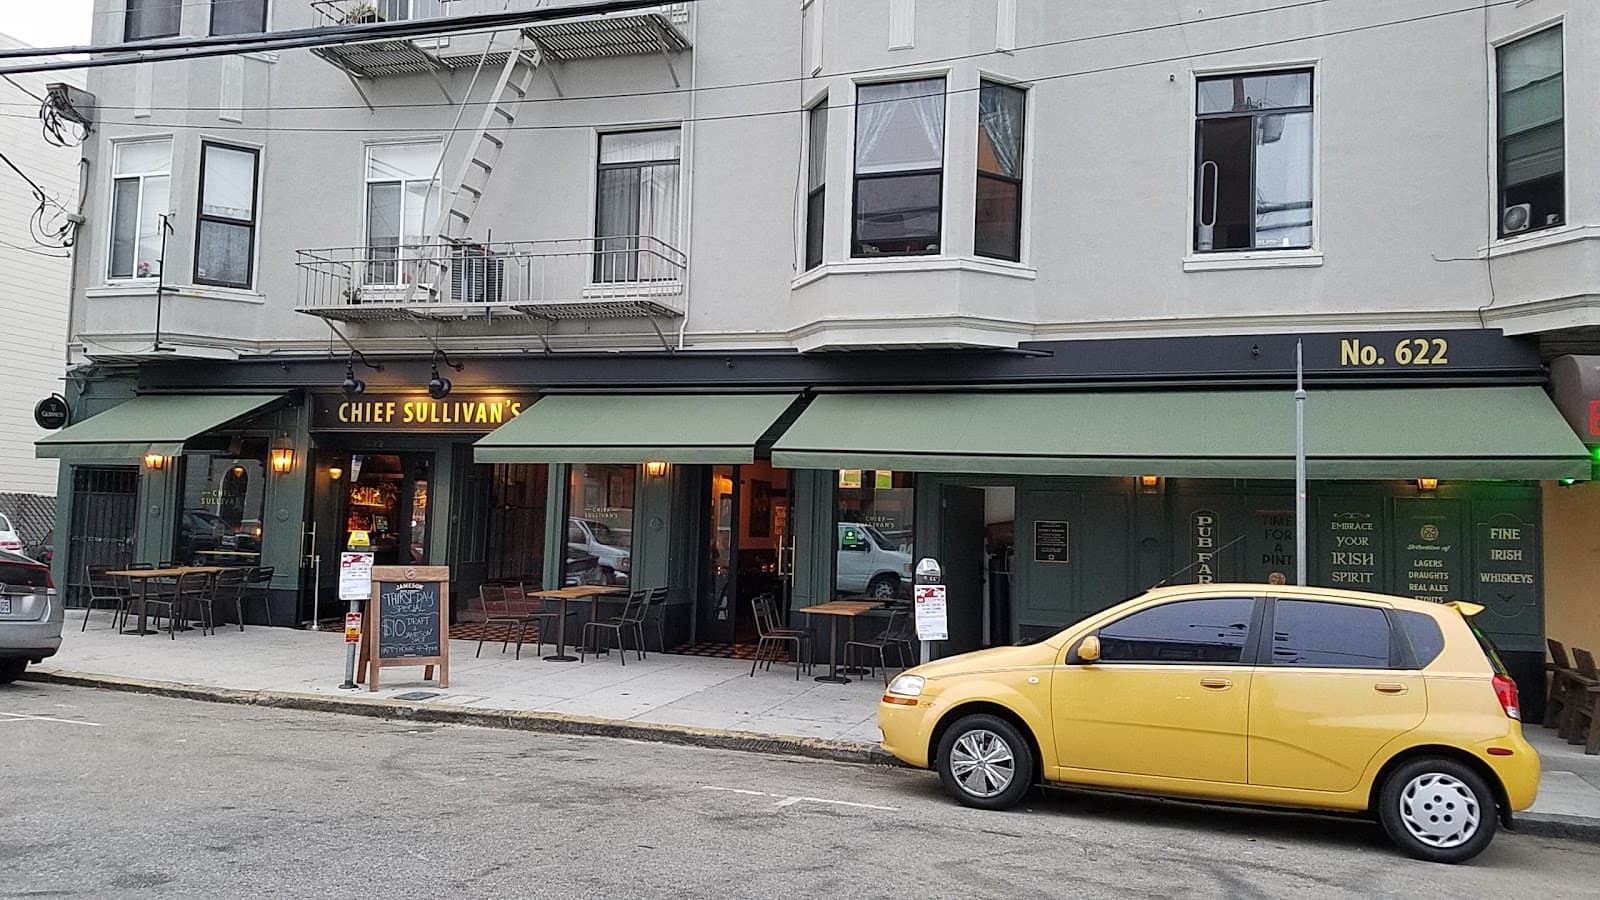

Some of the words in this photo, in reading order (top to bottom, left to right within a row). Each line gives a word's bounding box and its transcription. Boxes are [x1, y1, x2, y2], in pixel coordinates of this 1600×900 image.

[1341, 339, 1385, 366] No.
[1395, 338, 1448, 365] 622
[338, 402, 396, 423] CHIEF
[403, 400, 521, 423] SULLIVAN'S
[1263, 515, 1293, 527] TIME
[1331, 522, 1373, 530] EMBRACE
[1197, 516, 1213, 548] PUB
[1265, 529, 1293, 540] FOR
[1490, 528, 1520, 540] FINE
[1274, 543, 1283, 552] A
[1336, 537, 1369, 547] YOUR
[1262, 553, 1293, 565] PINT
[1331, 552, 1374, 566] IRISH
[1491, 549, 1522, 560] IRISH
[1414, 560, 1443, 568] LAGERS
[1331, 571, 1374, 583] SPIRIT
[1408, 572, 1449, 580] DRAUGHTS
[1480, 573, 1533, 584] WHISKEYS
[1408, 584, 1427, 592] REAL
[1429, 584, 1449, 592] ALES
[381, 618, 407, 637] $10
